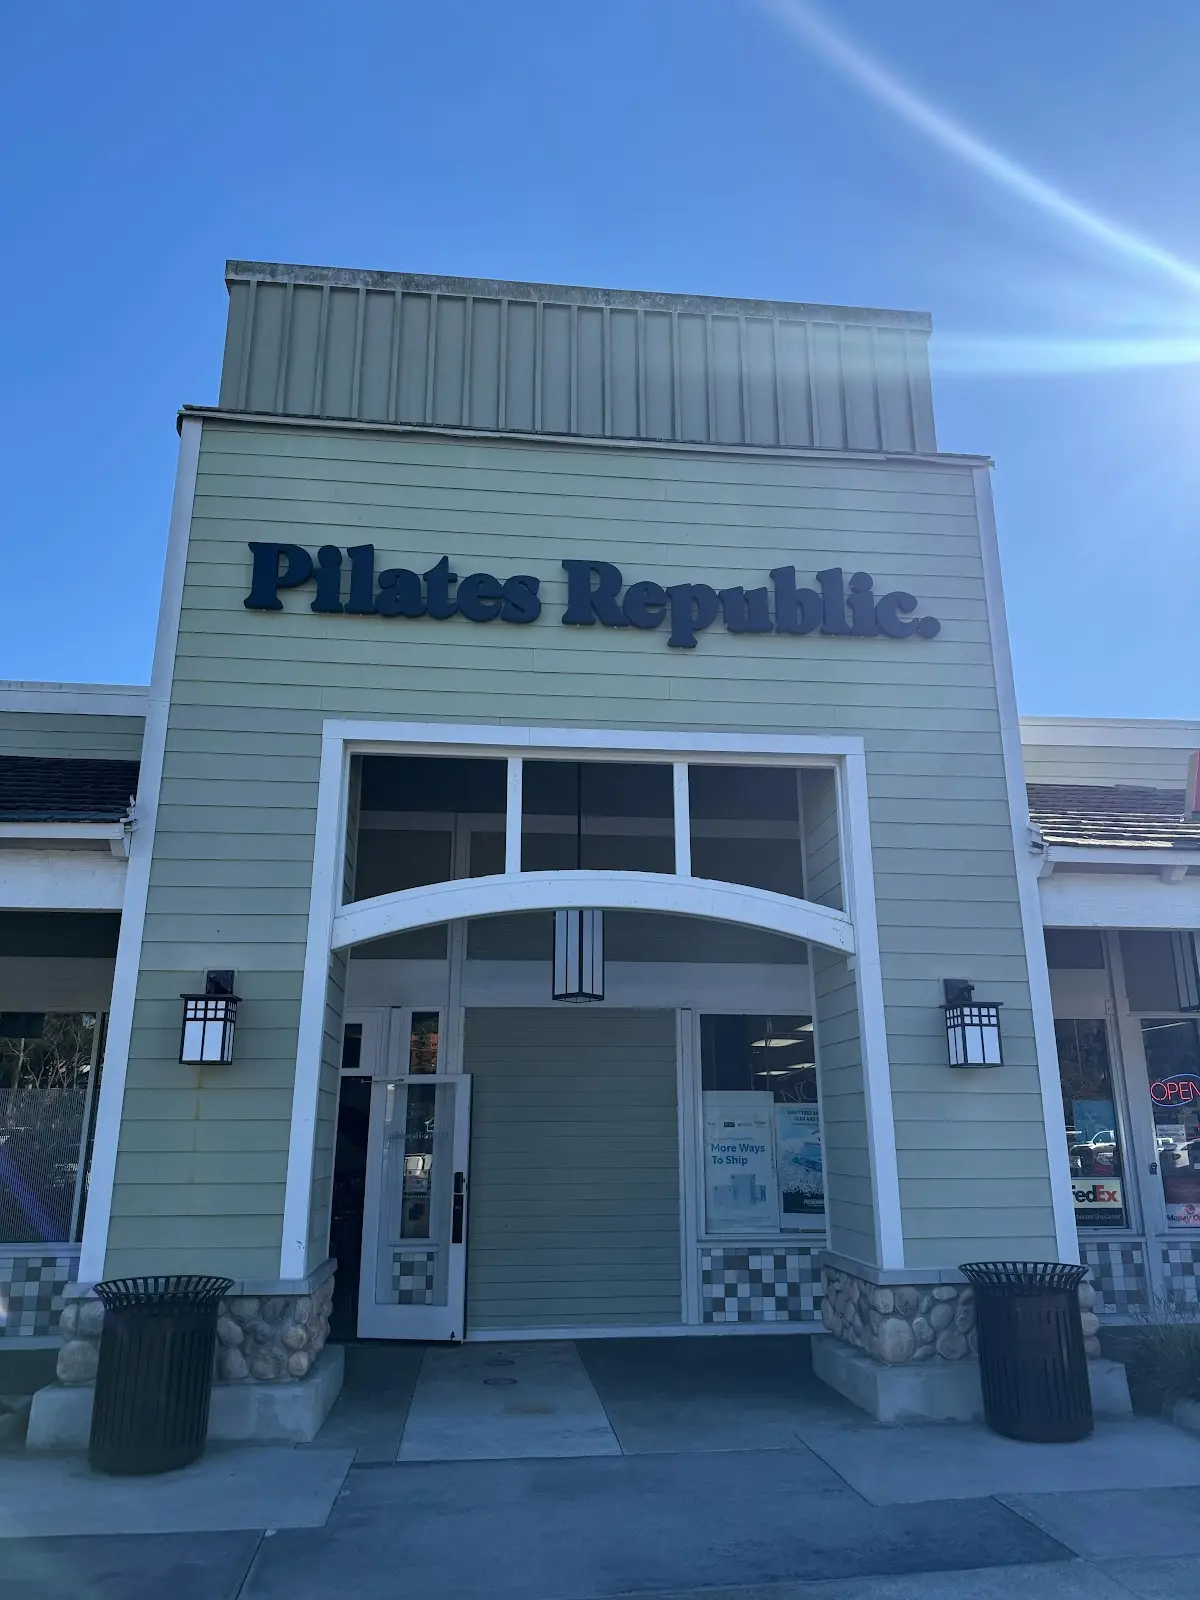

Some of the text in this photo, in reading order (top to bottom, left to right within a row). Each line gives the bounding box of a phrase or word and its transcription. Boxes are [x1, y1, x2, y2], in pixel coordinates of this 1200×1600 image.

[244, 541, 941, 648] Pilates Republic.
[711, 1143, 765, 1154] More Ways
[711, 1155, 748, 1166] To Ship
[1167, 1214, 1192, 1224] Money
